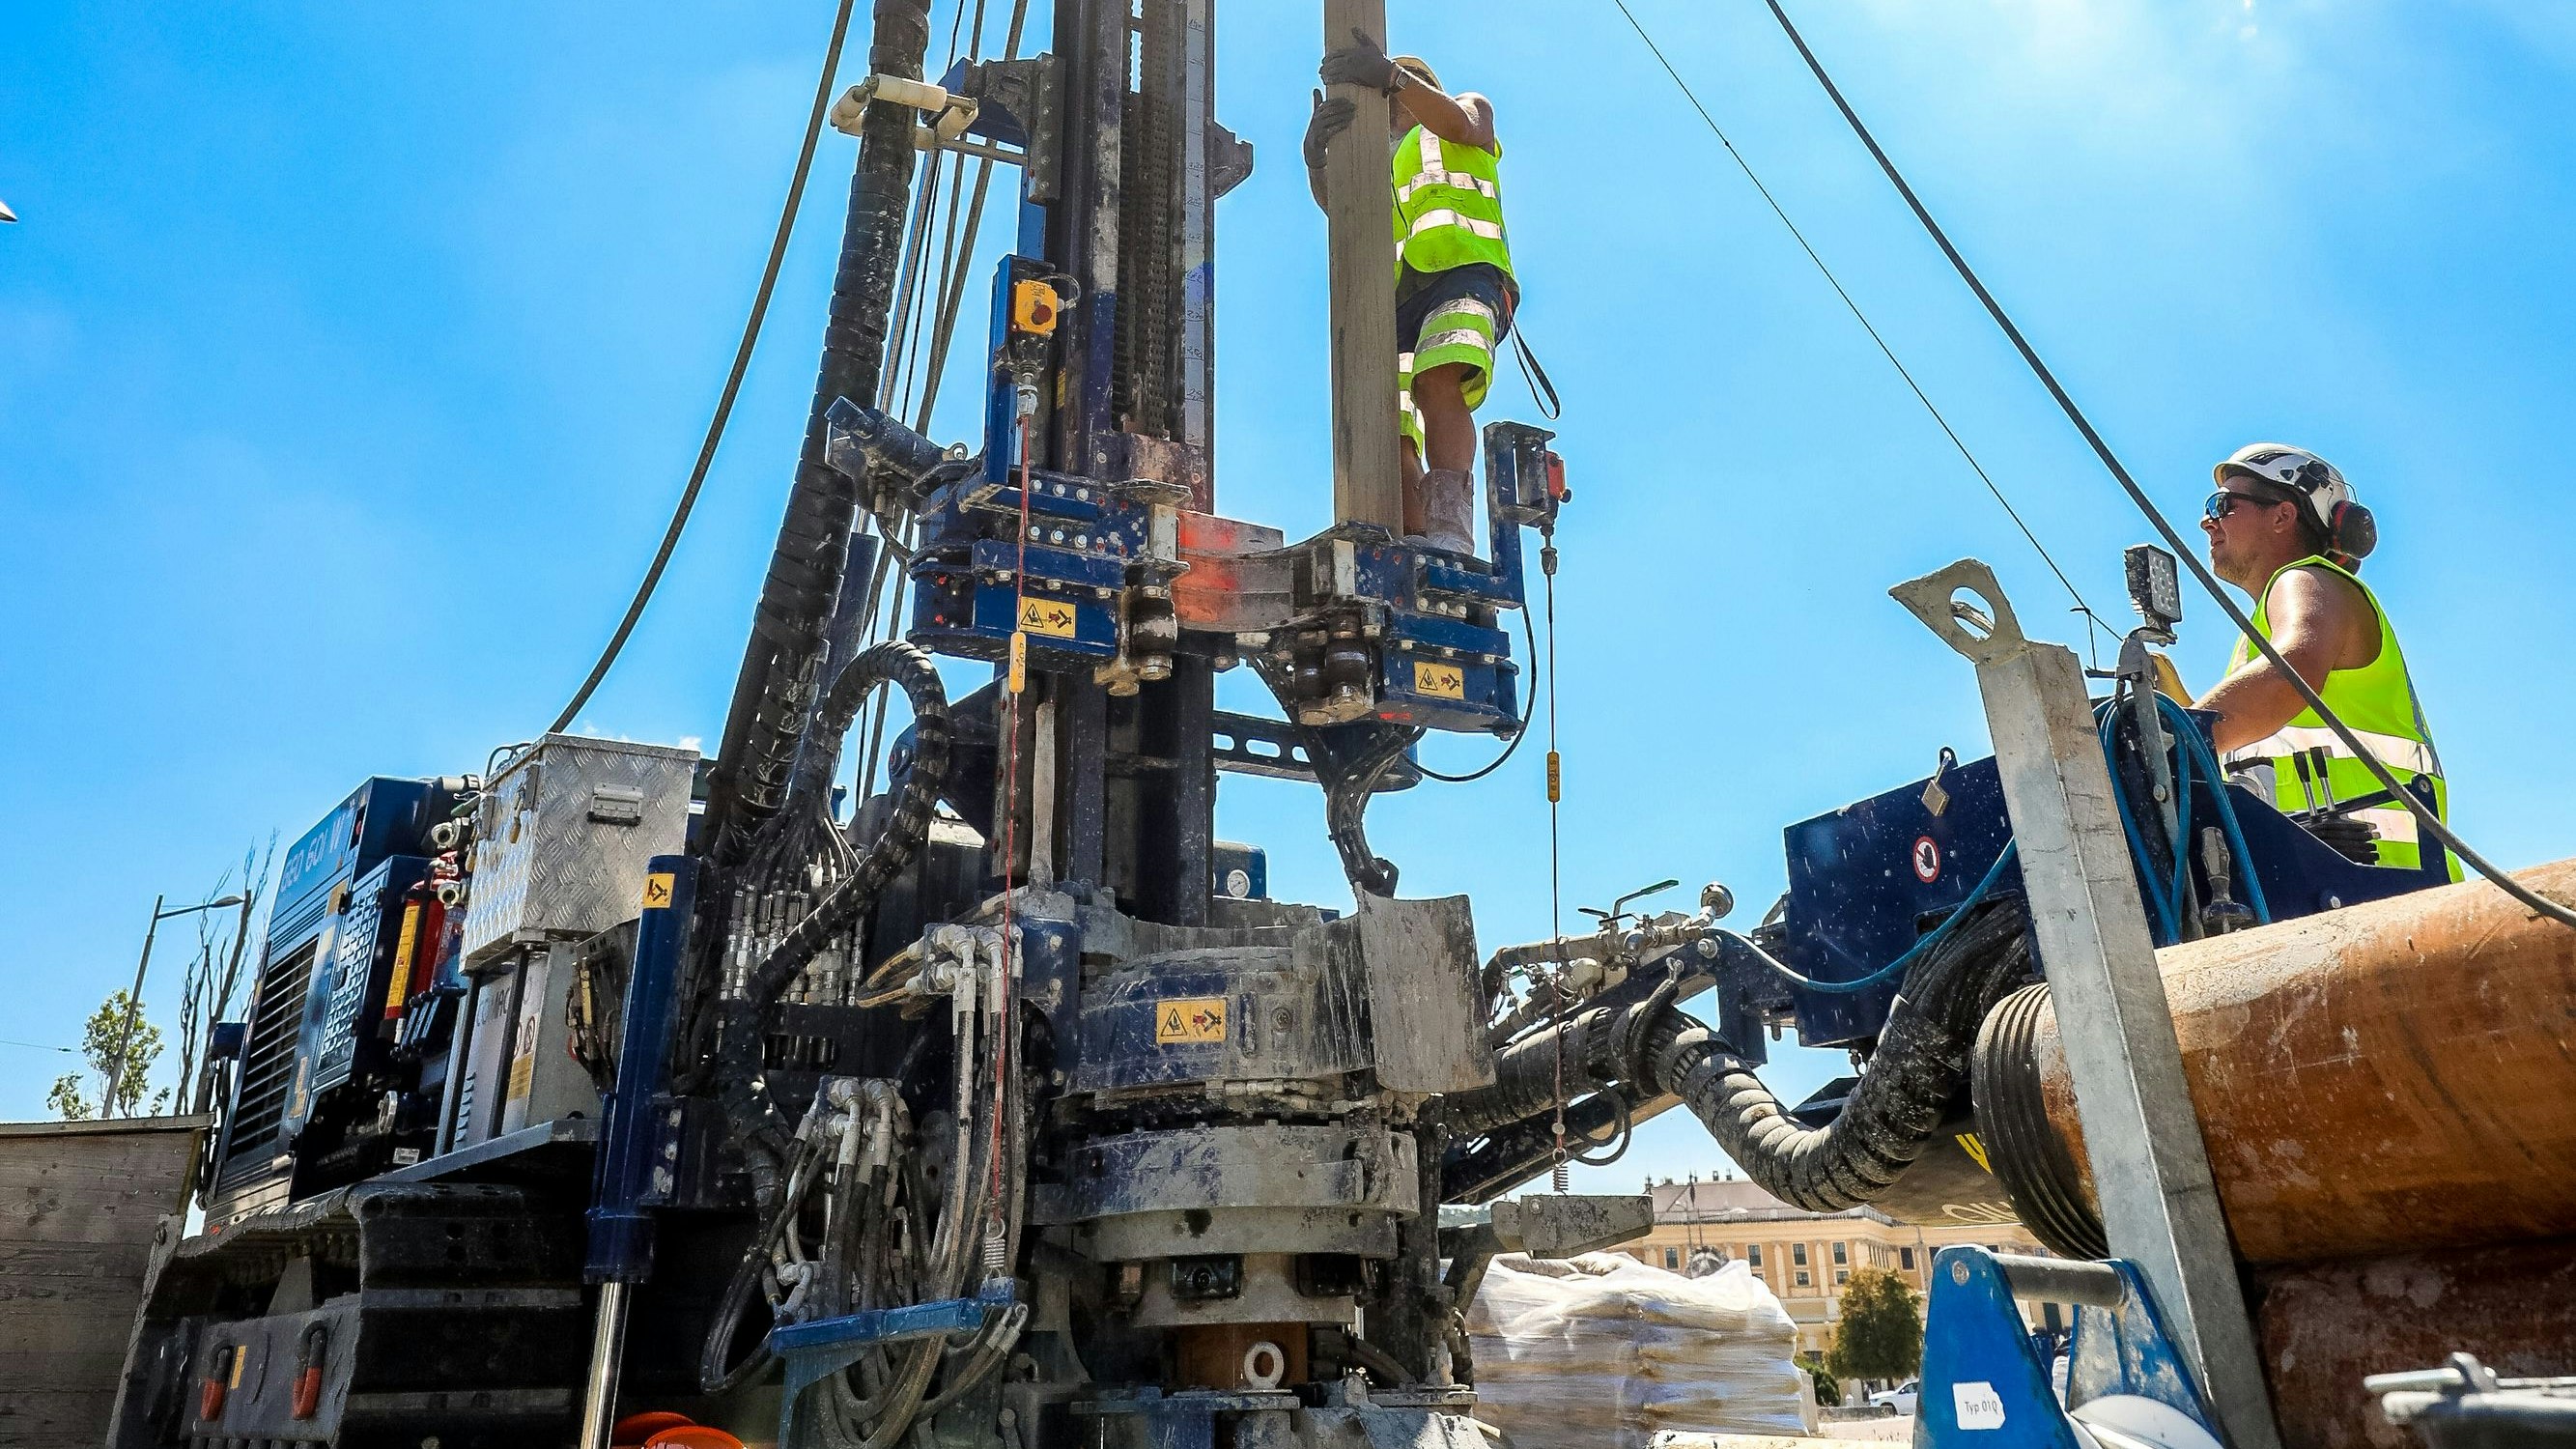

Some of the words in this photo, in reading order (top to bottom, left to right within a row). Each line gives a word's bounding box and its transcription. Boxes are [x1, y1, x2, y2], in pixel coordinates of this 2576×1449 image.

[280, 849, 304, 893] GEO
[305, 827, 328, 872] 601
[1964, 1401, 1980, 1415] Typ
